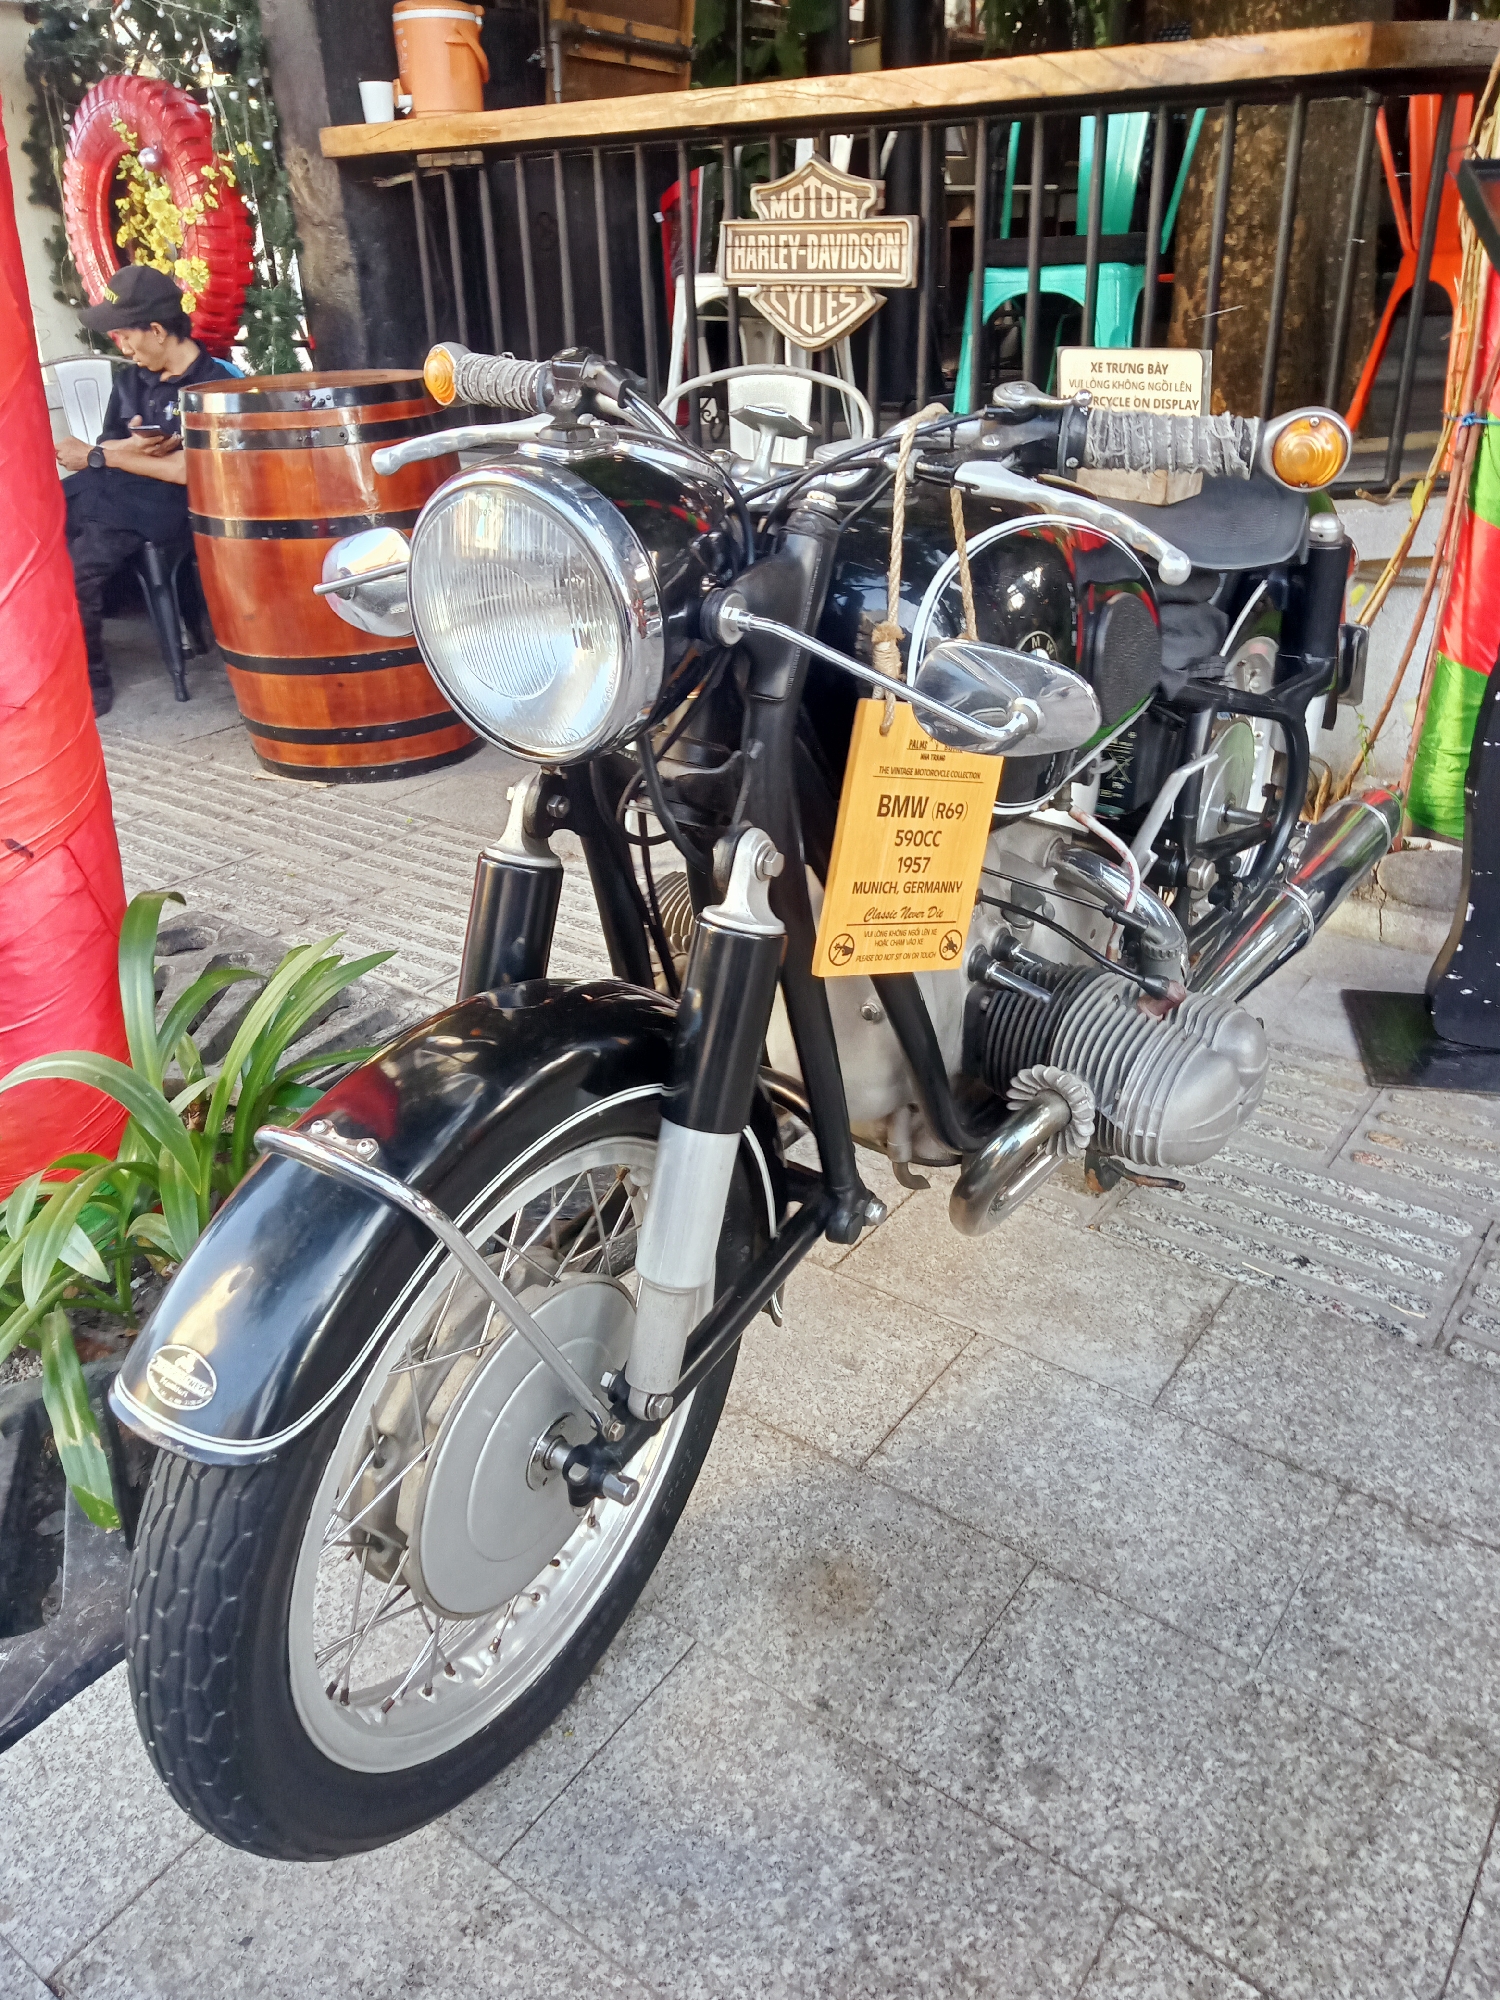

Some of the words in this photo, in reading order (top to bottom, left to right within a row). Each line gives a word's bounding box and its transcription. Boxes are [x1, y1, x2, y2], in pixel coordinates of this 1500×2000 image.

[770, 175, 858, 219] MOTOR
[734, 232, 900, 270] HARLEY-DAVIDSON
[770, 286, 856, 335] CYCLES
[1091, 362, 1103, 373] XE
[1106, 362, 1144, 375] TRƯNG
[1147, 361, 1168, 375] BÀY
[1069, 379, 1083, 389] VUI
[1085, 377, 1110, 390] LÒNG
[1112, 378, 1145, 391] KHÔNG
[1147, 378, 1172, 392] NGỒI
[1174, 381, 1192, 393] LÊN
[1133, 397, 1151, 409] ON
[1153, 398, 1200, 411] DISPLAY
[908, 739, 928, 750] PALMS
[879, 766, 890, 775] THE
[890, 766, 914, 776] VINTAGE
[914, 767, 950, 778] MOTORCYCLE
[950, 770, 981, 780] COLLECTION
[877, 794, 930, 819] BMW
[932, 800, 969, 822] (R69)
[894, 829, 942, 847] 590CC
[897, 856, 931, 874] 1957
[852, 881, 899, 895] MUNICH,
[903, 880, 963, 894] GERMANNY
[863, 906, 898, 923] Classic
[900, 906, 925, 920] Never
[927, 905, 944, 919] Die
[855, 954, 874, 962] PLEASE
[883, 953, 895, 961] NOT
[920, 951, 937, 959] TOUCH
